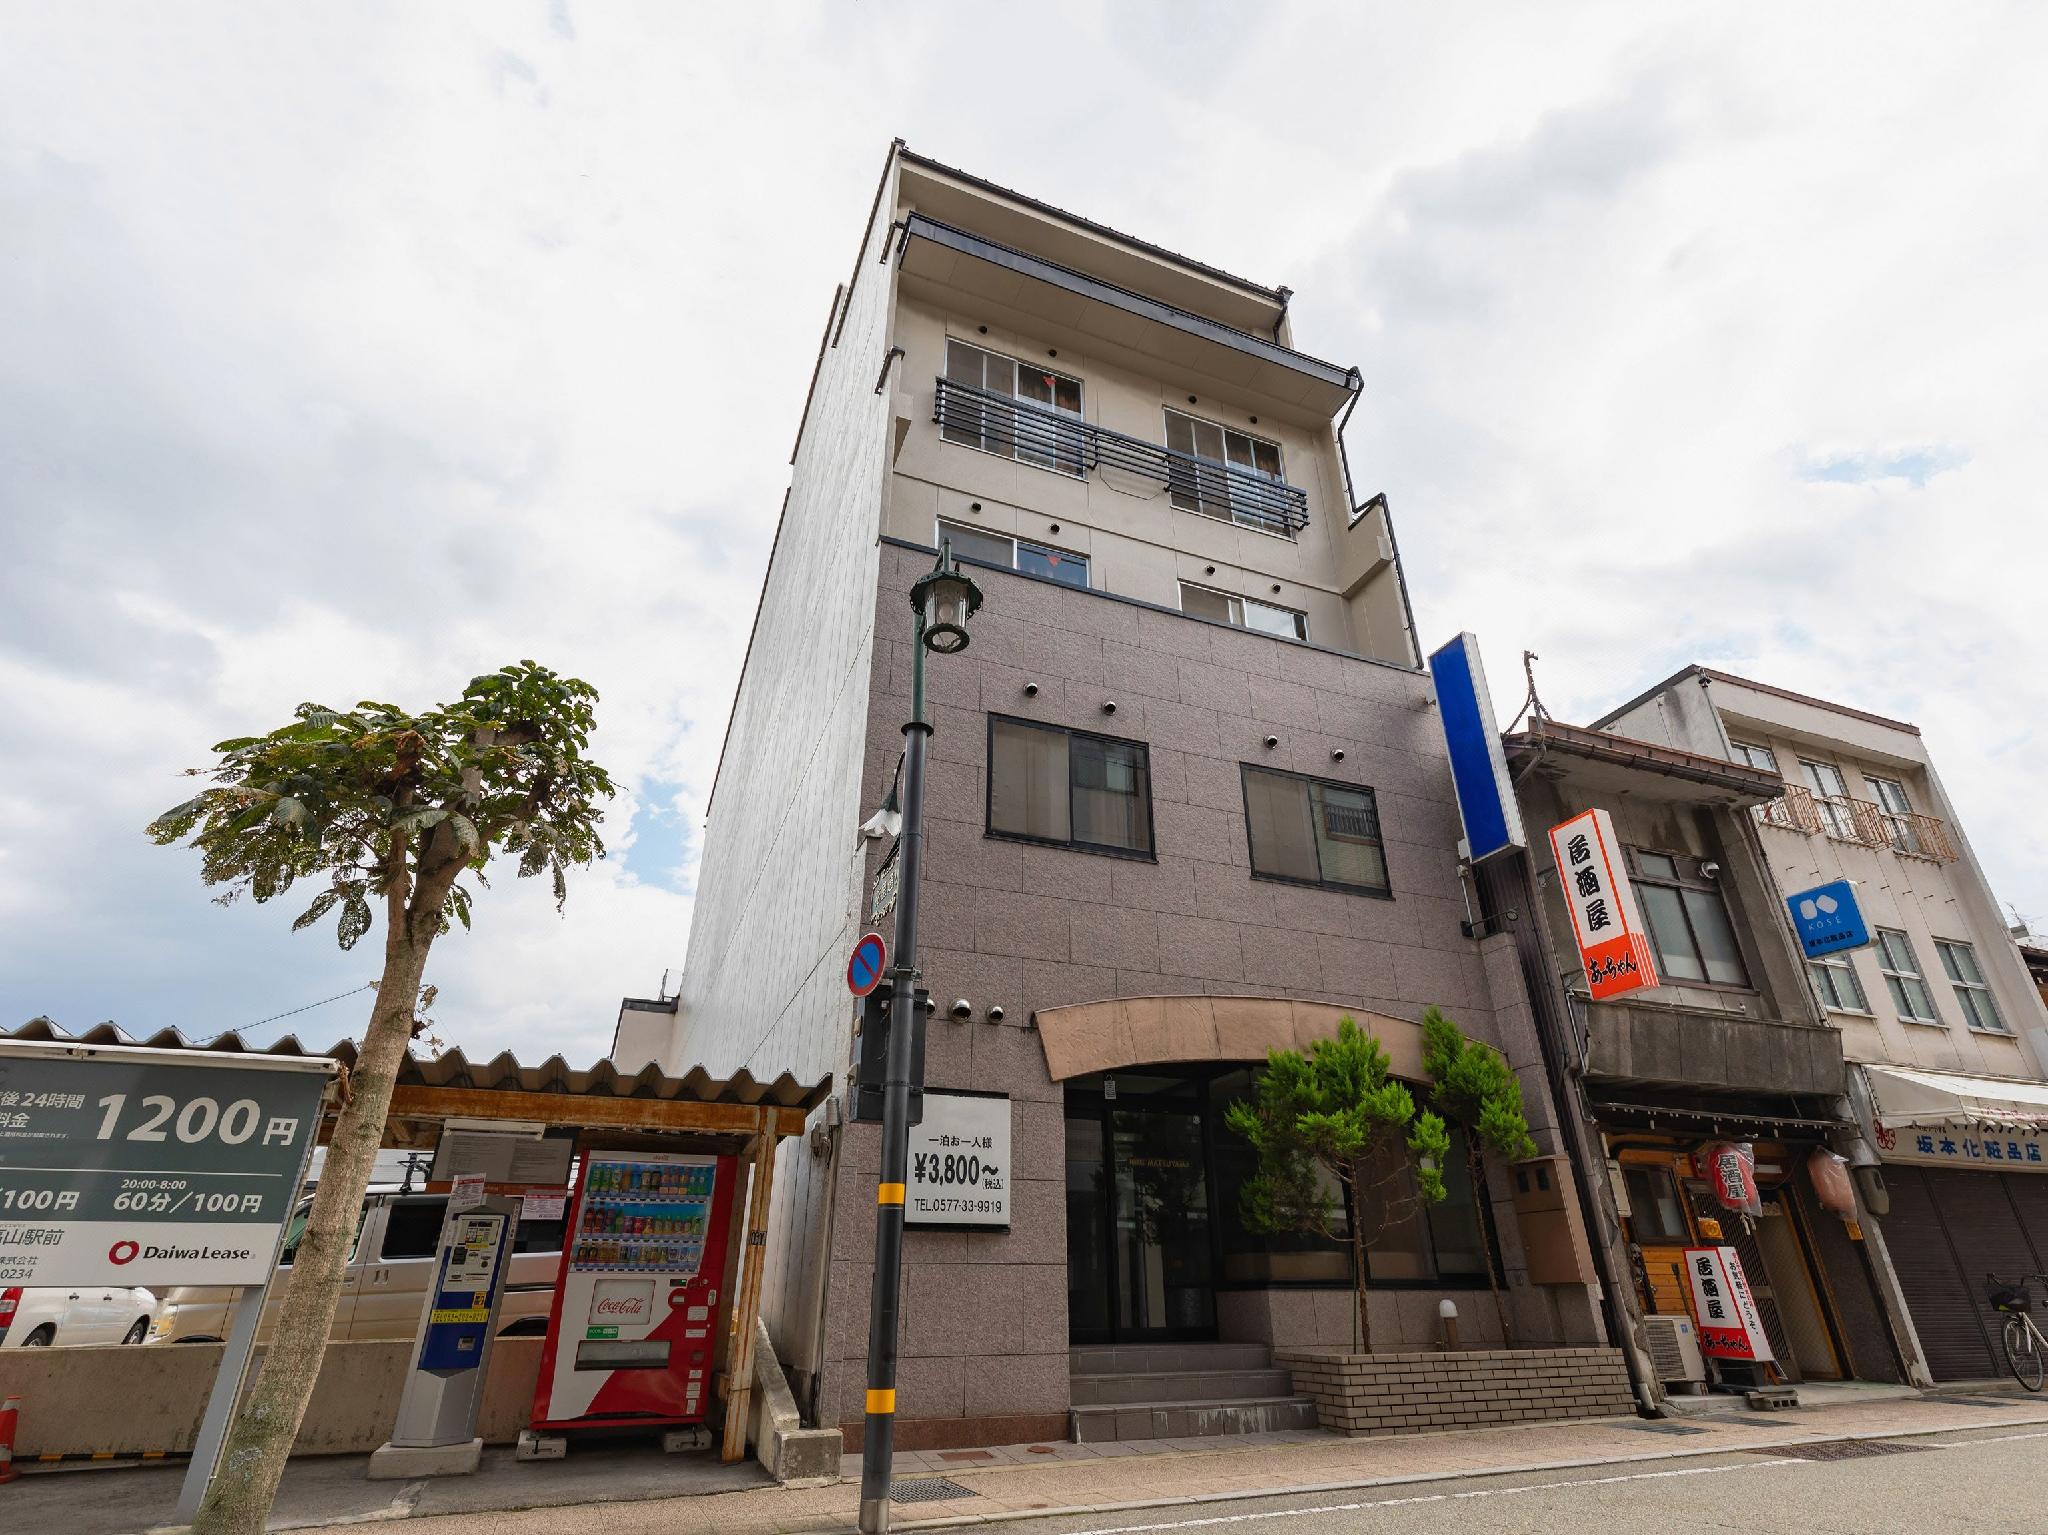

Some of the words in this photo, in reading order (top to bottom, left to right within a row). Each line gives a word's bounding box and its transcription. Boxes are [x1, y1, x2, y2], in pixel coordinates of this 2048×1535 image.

[1568, 834, 1611, 932] 居酒屋
[0, 1091, 86, 1109] 後24時間
[95, 1094, 299, 1147] 1200円
[928, 1135, 993, 1149] 一泊お一人様
[1916, 1134, 2042, 1162] 坂本化粧品店
[120, 1179, 187, 1190] 20:00-8:00
[1717, 1153, 1748, 1200] 居酒屋
[0, 1187, 80, 1211] 100円
[914, 1198, 1002, 1213] TEL.0577-33-9919
[143, 1245, 199, 1259] Daiwa
[200, 1246, 250, 1259] Lease
[1695, 1256, 1726, 1320] 居酒屋
